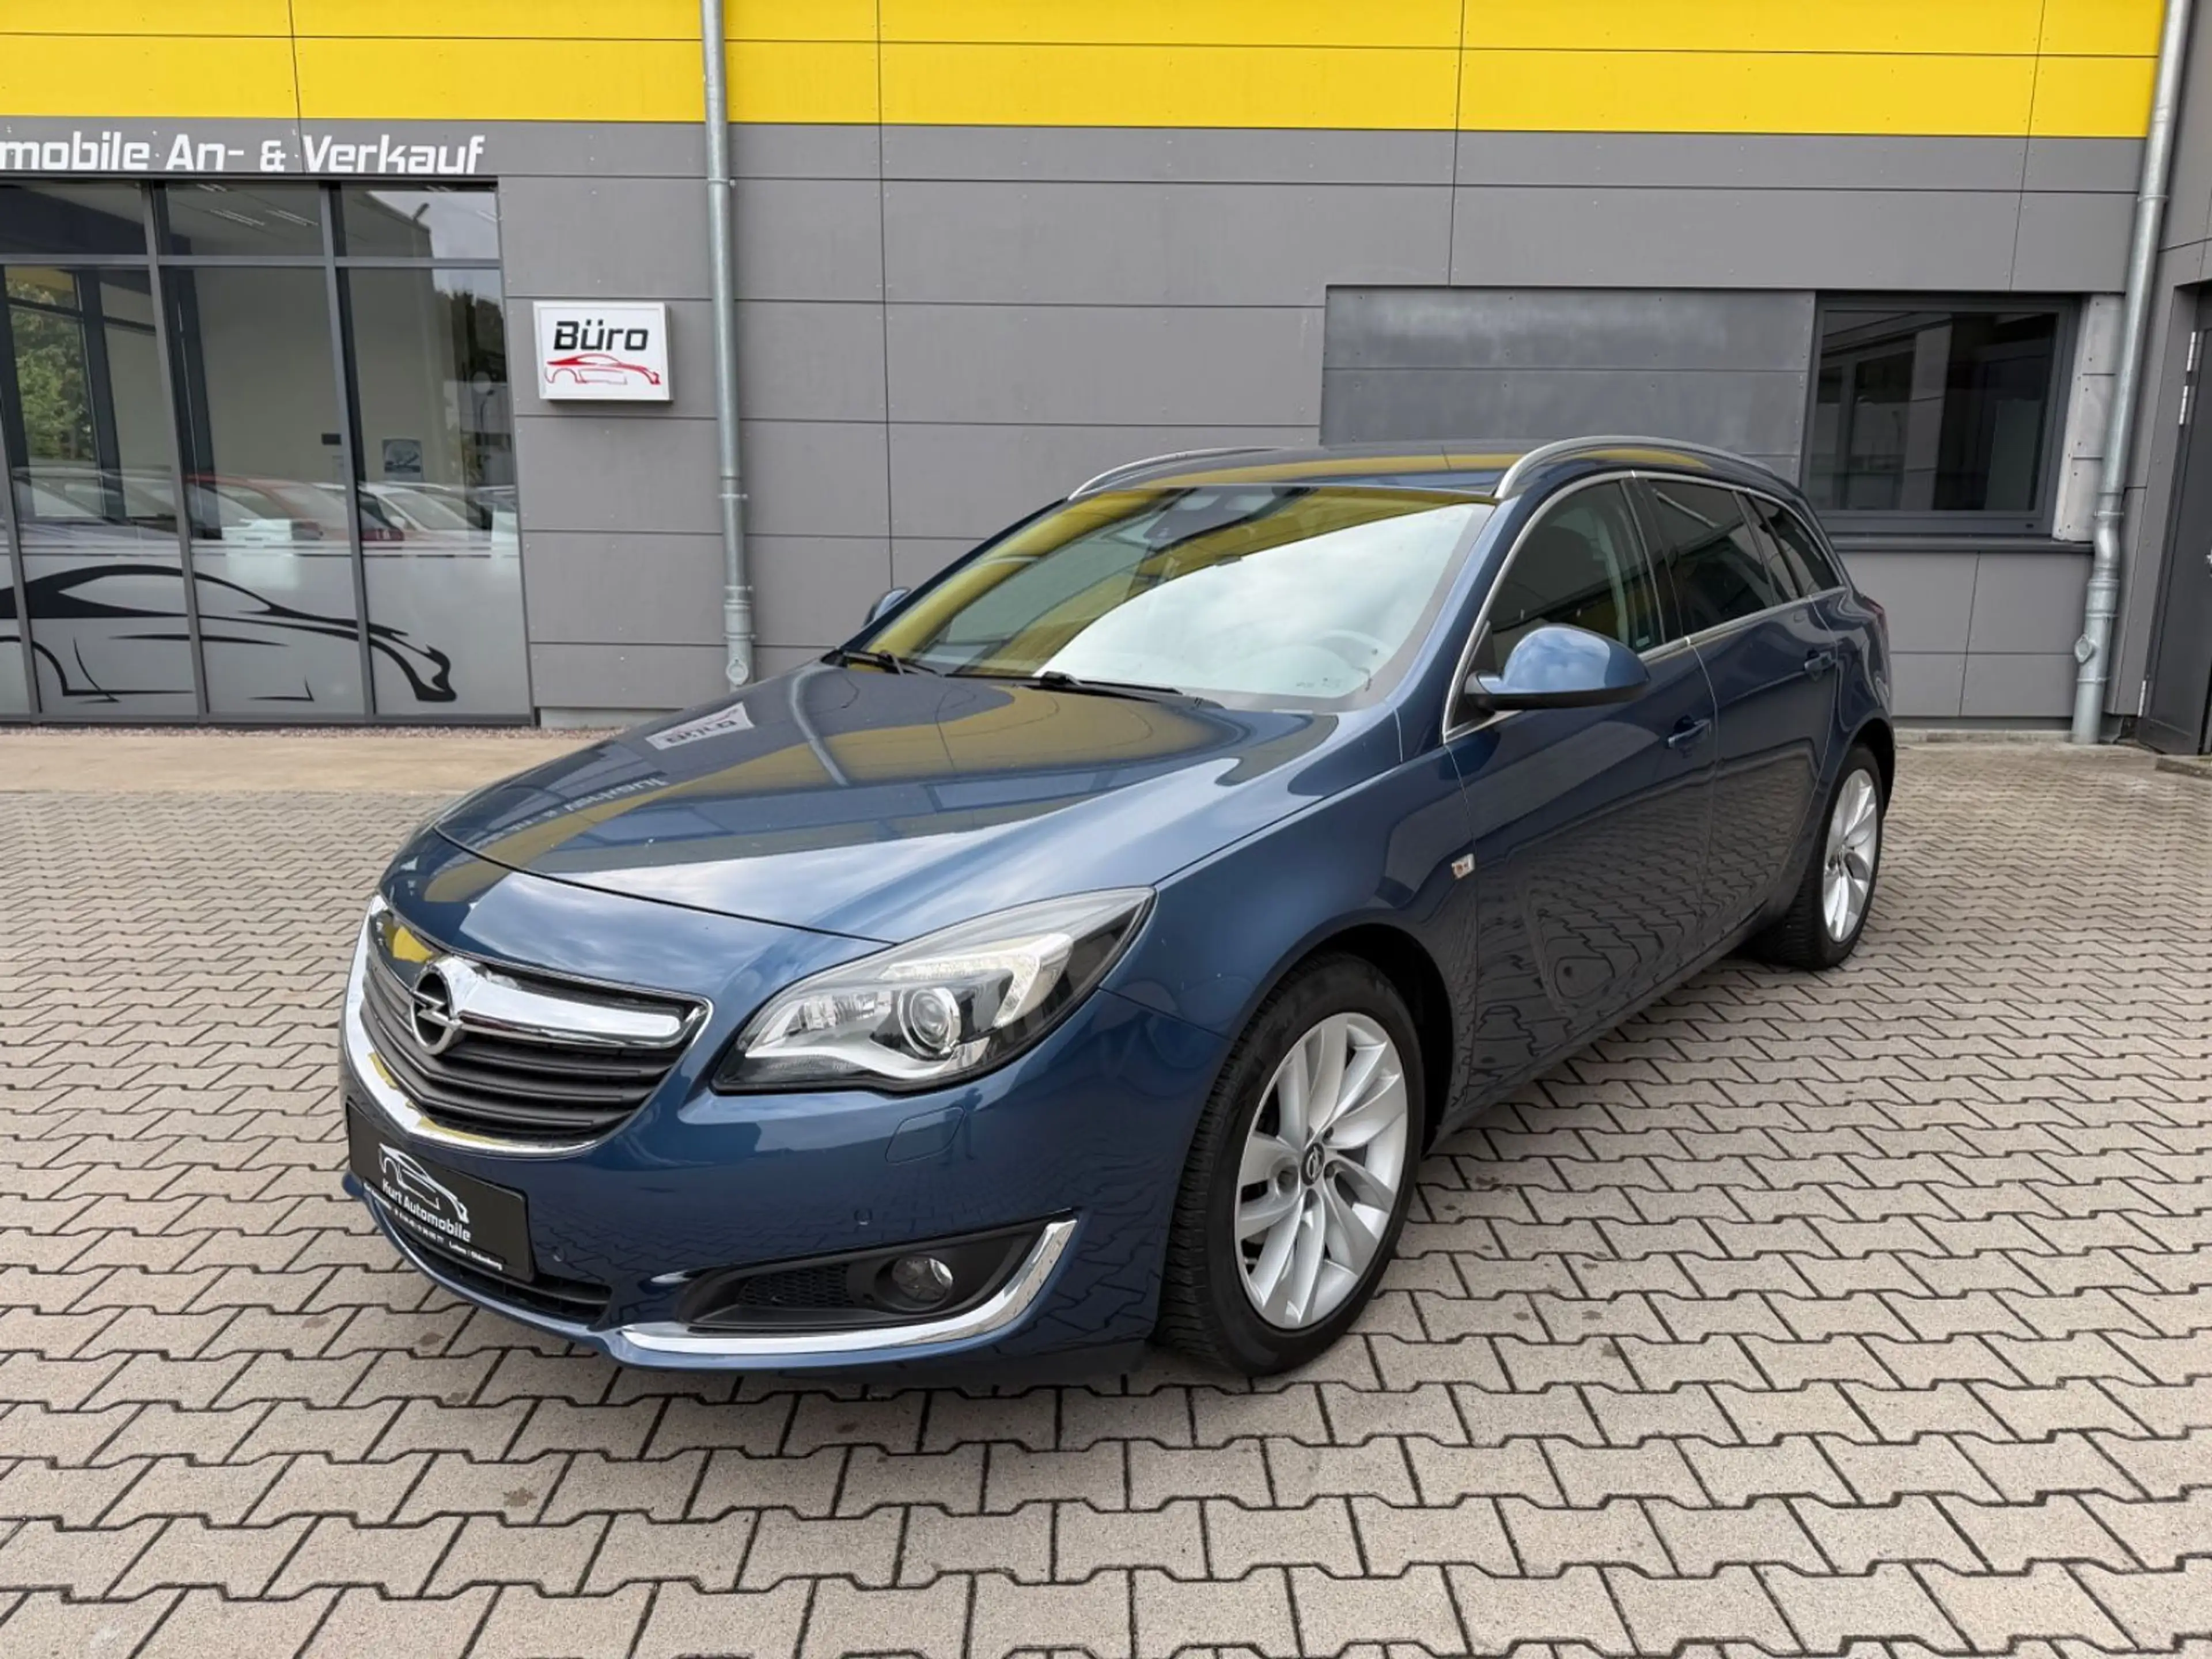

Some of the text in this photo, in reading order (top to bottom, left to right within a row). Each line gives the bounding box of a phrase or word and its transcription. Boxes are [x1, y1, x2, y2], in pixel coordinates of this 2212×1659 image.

[0, 131, 485, 173] mobile An- & Verkauf
[554, 319, 649, 351] Büro
[382, 1177, 403, 1206] Kurt
[403, 1195, 471, 1243] Automobile
